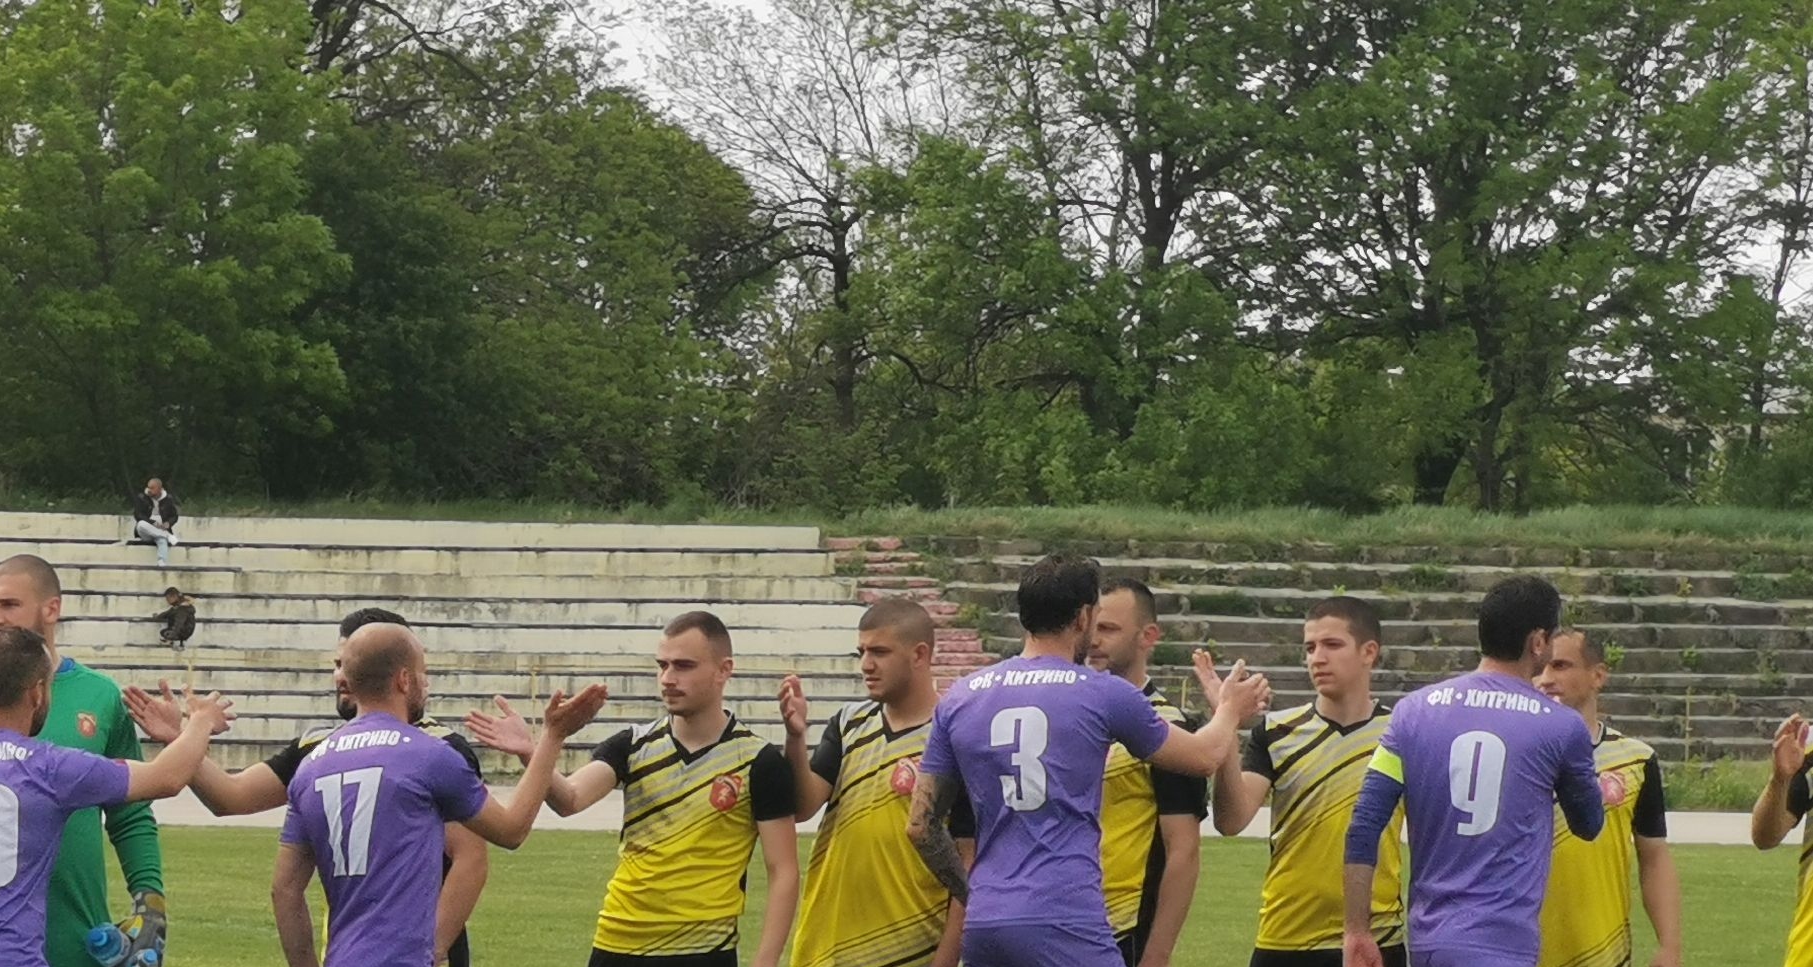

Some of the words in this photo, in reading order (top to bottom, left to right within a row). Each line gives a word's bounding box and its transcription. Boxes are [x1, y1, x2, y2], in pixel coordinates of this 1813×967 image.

[1003, 669, 1077, 687] ХИТРИНО
[1463, 688, 1541, 715] ХИТРИНО
[990, 706, 1048, 811] 3
[1449, 730, 1506, 836] 9
[315, 766, 384, 877] 17
